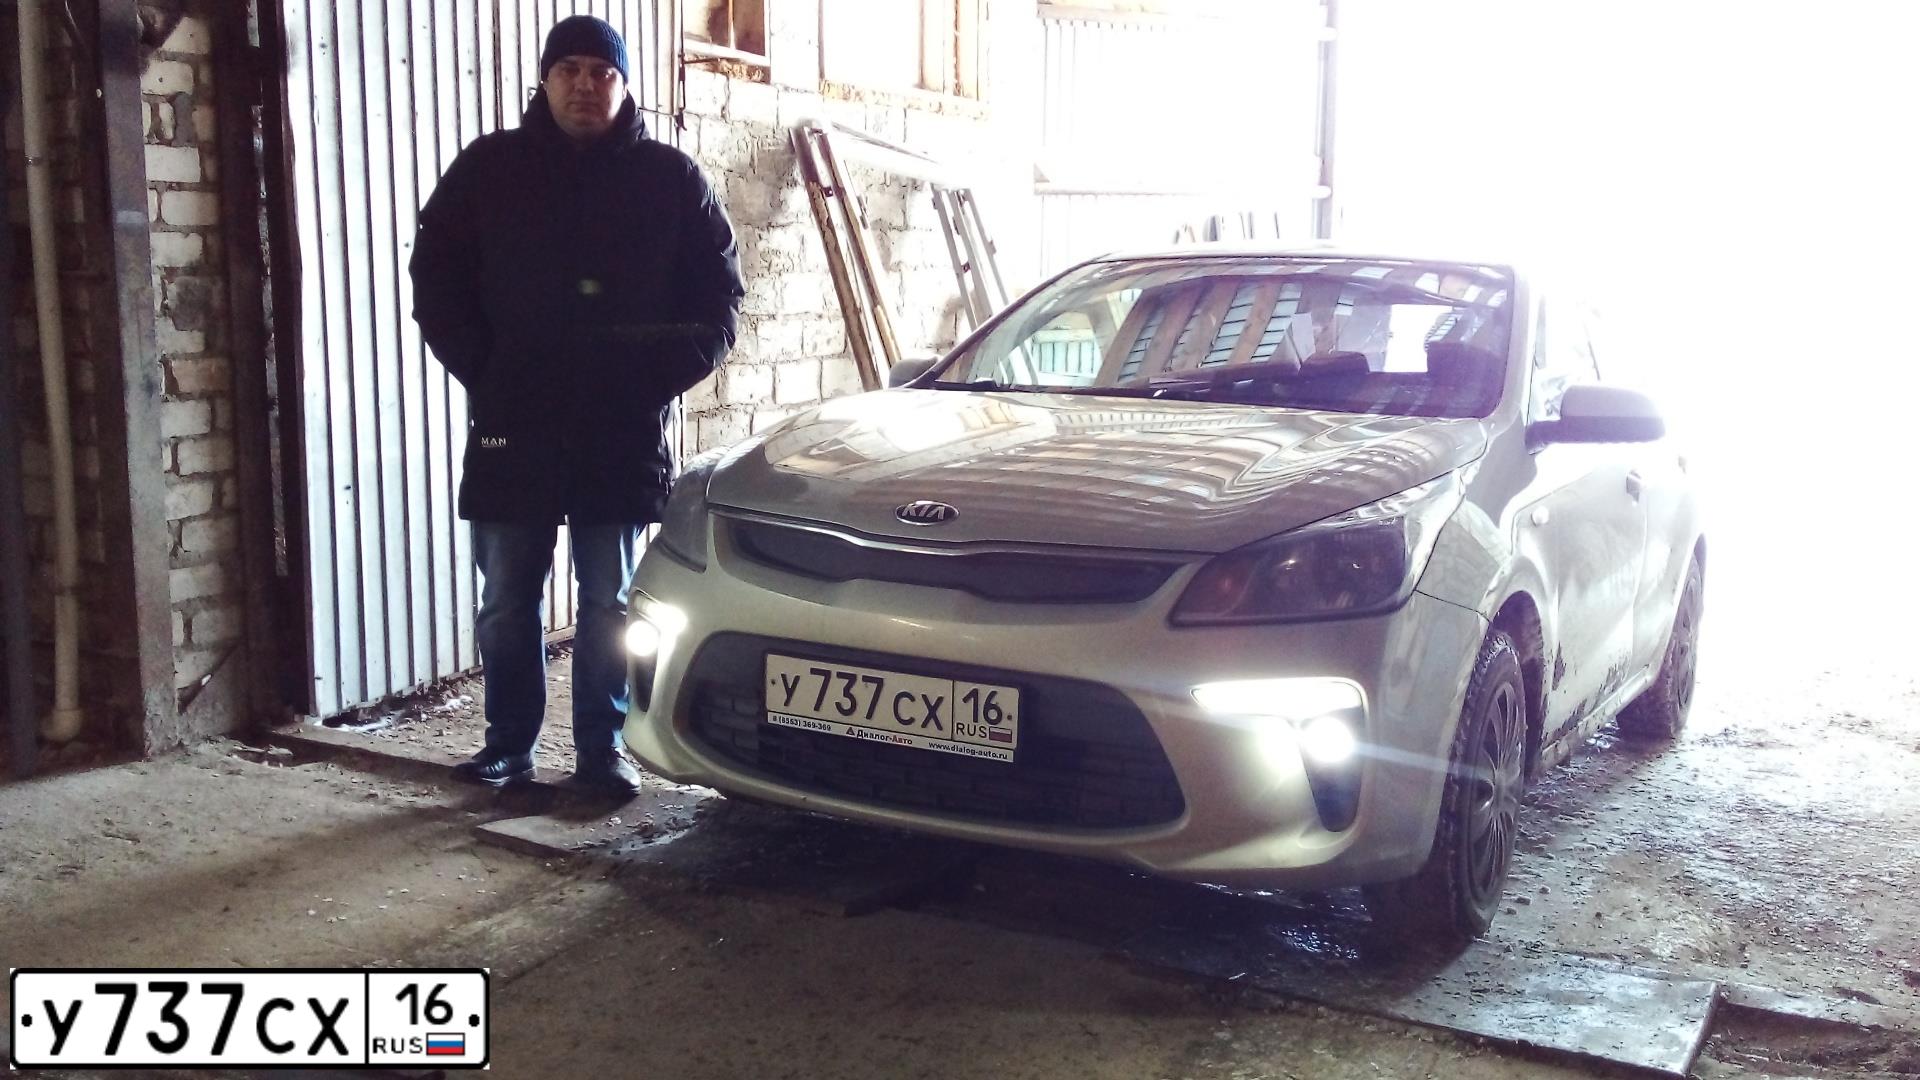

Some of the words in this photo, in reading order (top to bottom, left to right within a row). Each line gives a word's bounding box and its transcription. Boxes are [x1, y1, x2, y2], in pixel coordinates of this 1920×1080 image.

[481, 437, 506, 446] MAN
[902, 503, 945, 520] KIA
[961, 688, 1002, 725] 16
[803, 720, 831, 731] 369-369
[955, 722, 987, 739] RUS
[857, 729, 912, 744] Диалог-Авто
[928, 742, 1007, 759] www.dialog-auto.ru
